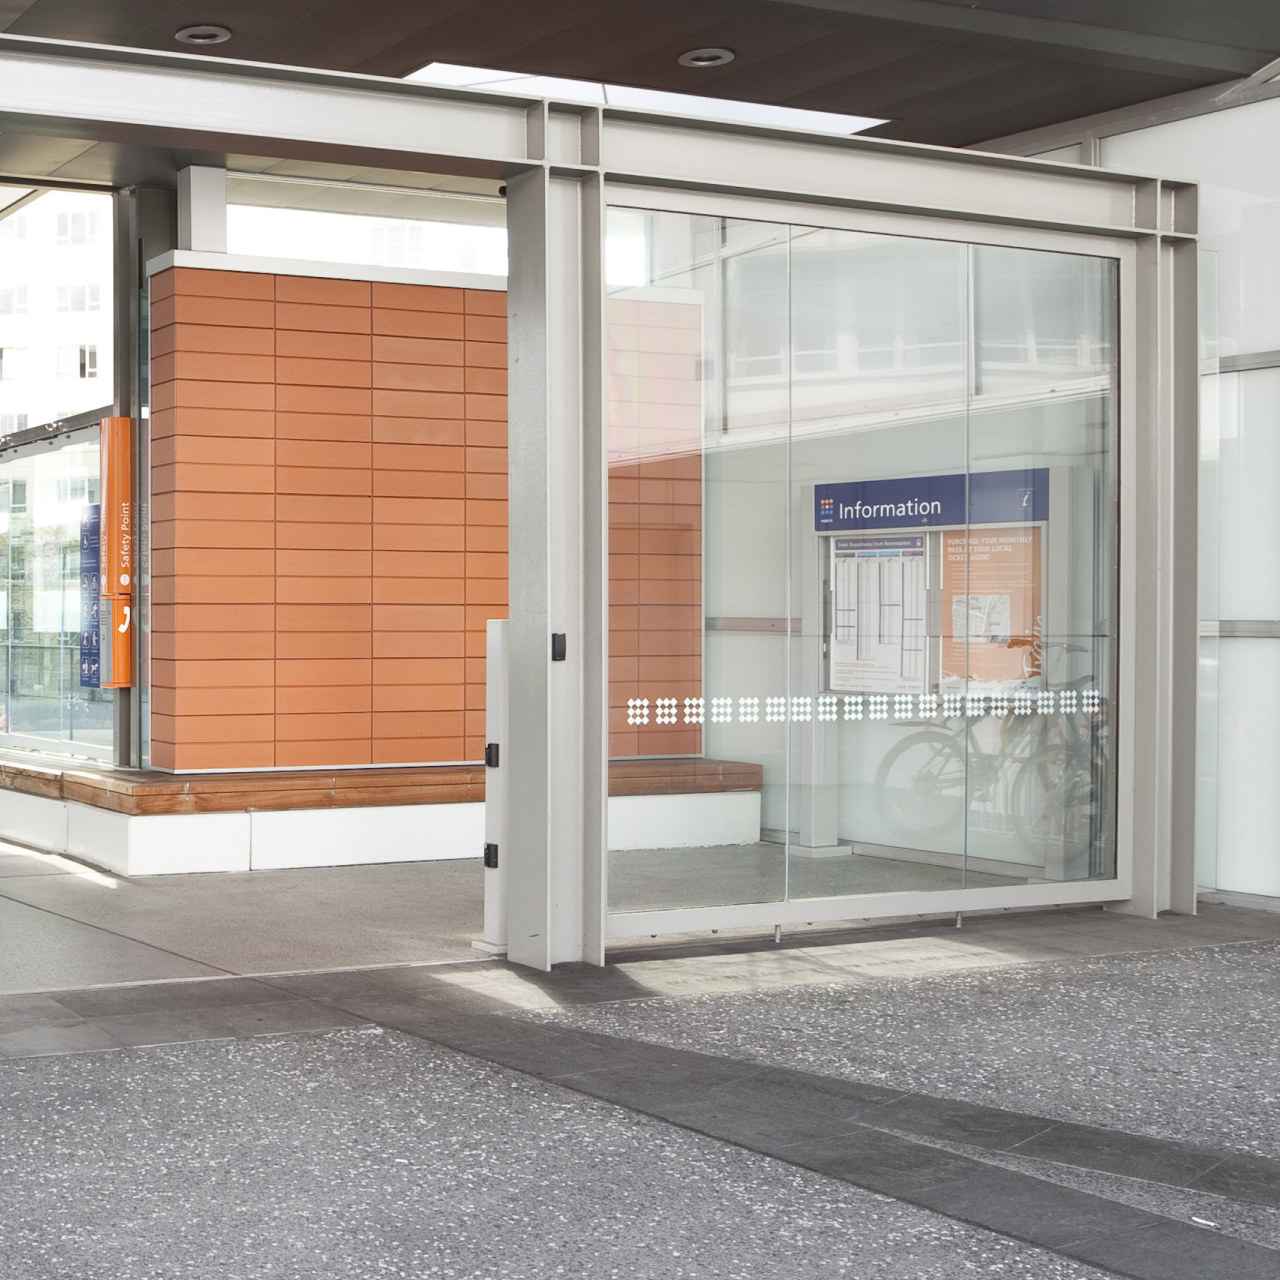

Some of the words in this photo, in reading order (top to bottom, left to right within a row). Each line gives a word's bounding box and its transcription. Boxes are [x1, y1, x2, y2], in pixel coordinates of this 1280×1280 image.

[120, 502, 131, 531] Point
[839, 498, 941, 520] Information
[120, 533, 132, 568] Safety
